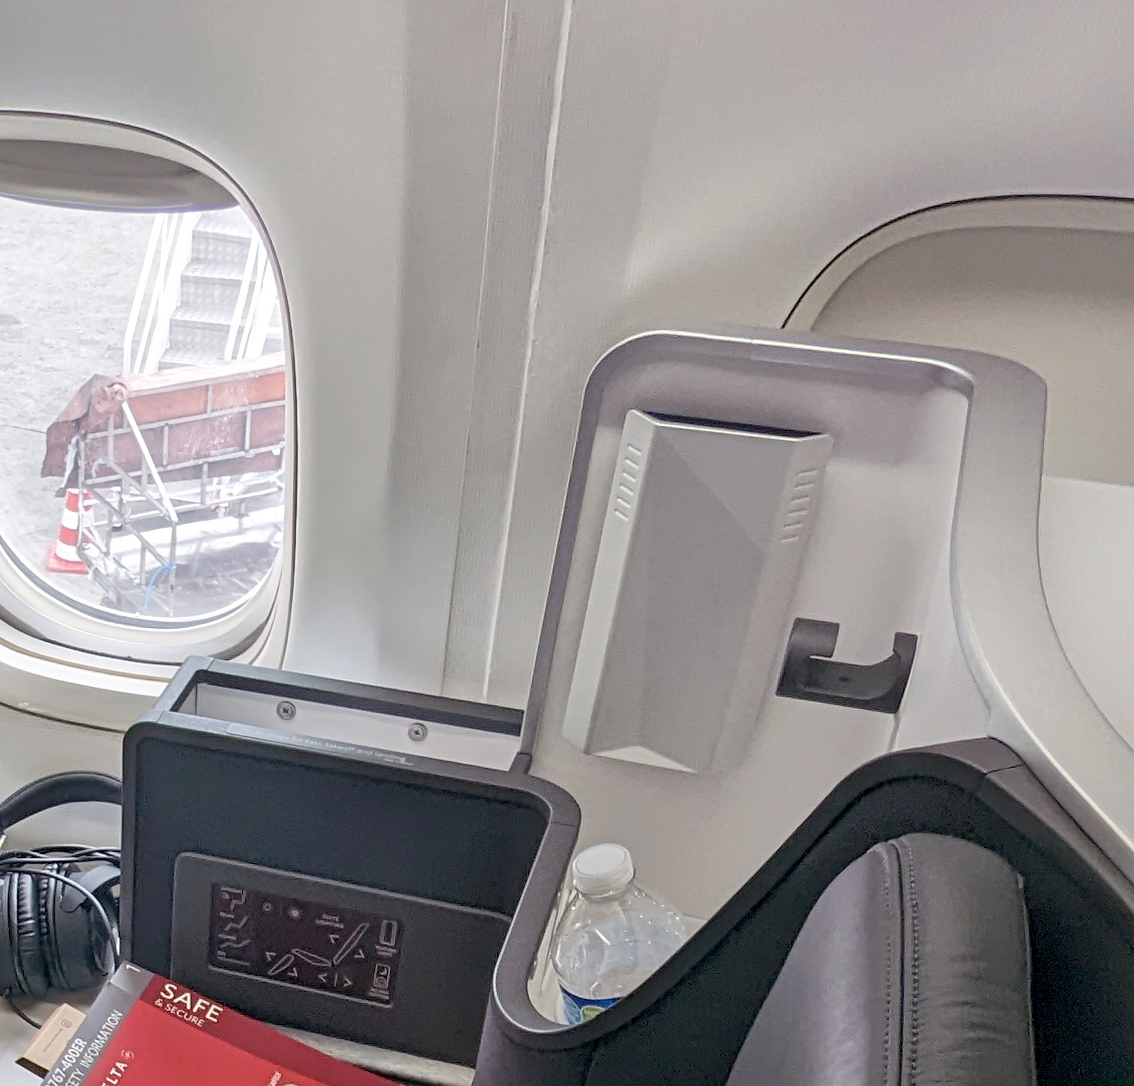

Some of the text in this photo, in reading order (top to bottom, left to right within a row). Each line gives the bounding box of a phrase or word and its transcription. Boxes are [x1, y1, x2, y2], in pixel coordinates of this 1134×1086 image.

[154, 998, 206, 1028] & SECURE
[160, 983, 224, 1023] SAFE
[79, 1009, 123, 1069] INFORMATION
